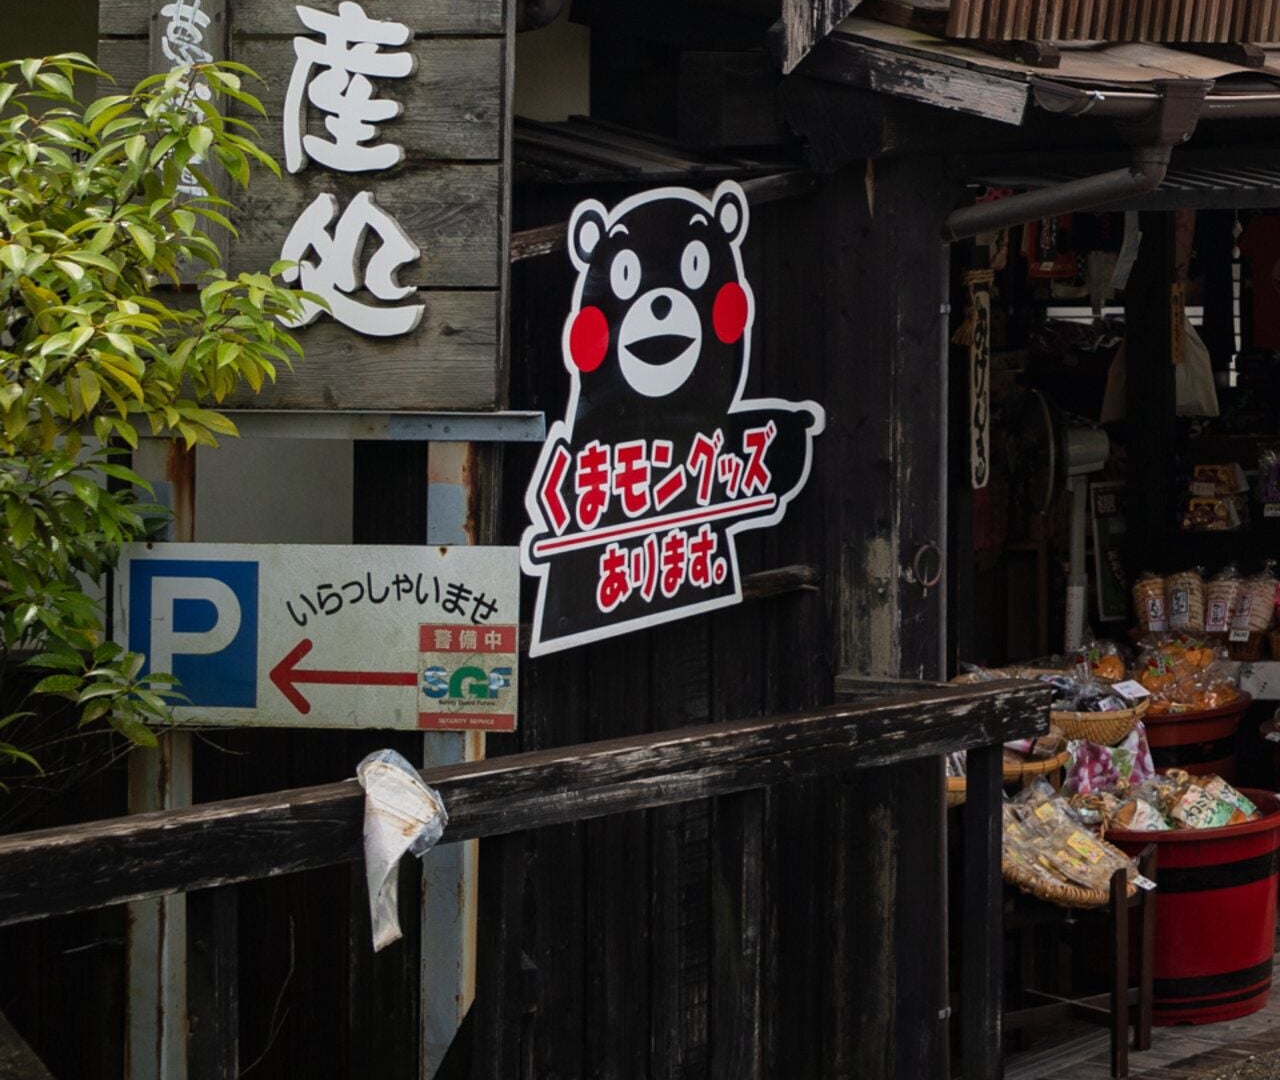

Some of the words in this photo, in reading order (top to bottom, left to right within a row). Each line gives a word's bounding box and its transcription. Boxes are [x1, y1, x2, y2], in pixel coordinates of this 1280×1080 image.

[541, 419, 778, 537] くまモングッズ
[286, 571, 499, 627] いらっしゃいませ
[596, 522, 728, 614] あります。
[150, 576, 242, 690] P
[433, 628, 502, 651] 警備中
[422, 665, 513, 699] SGF
